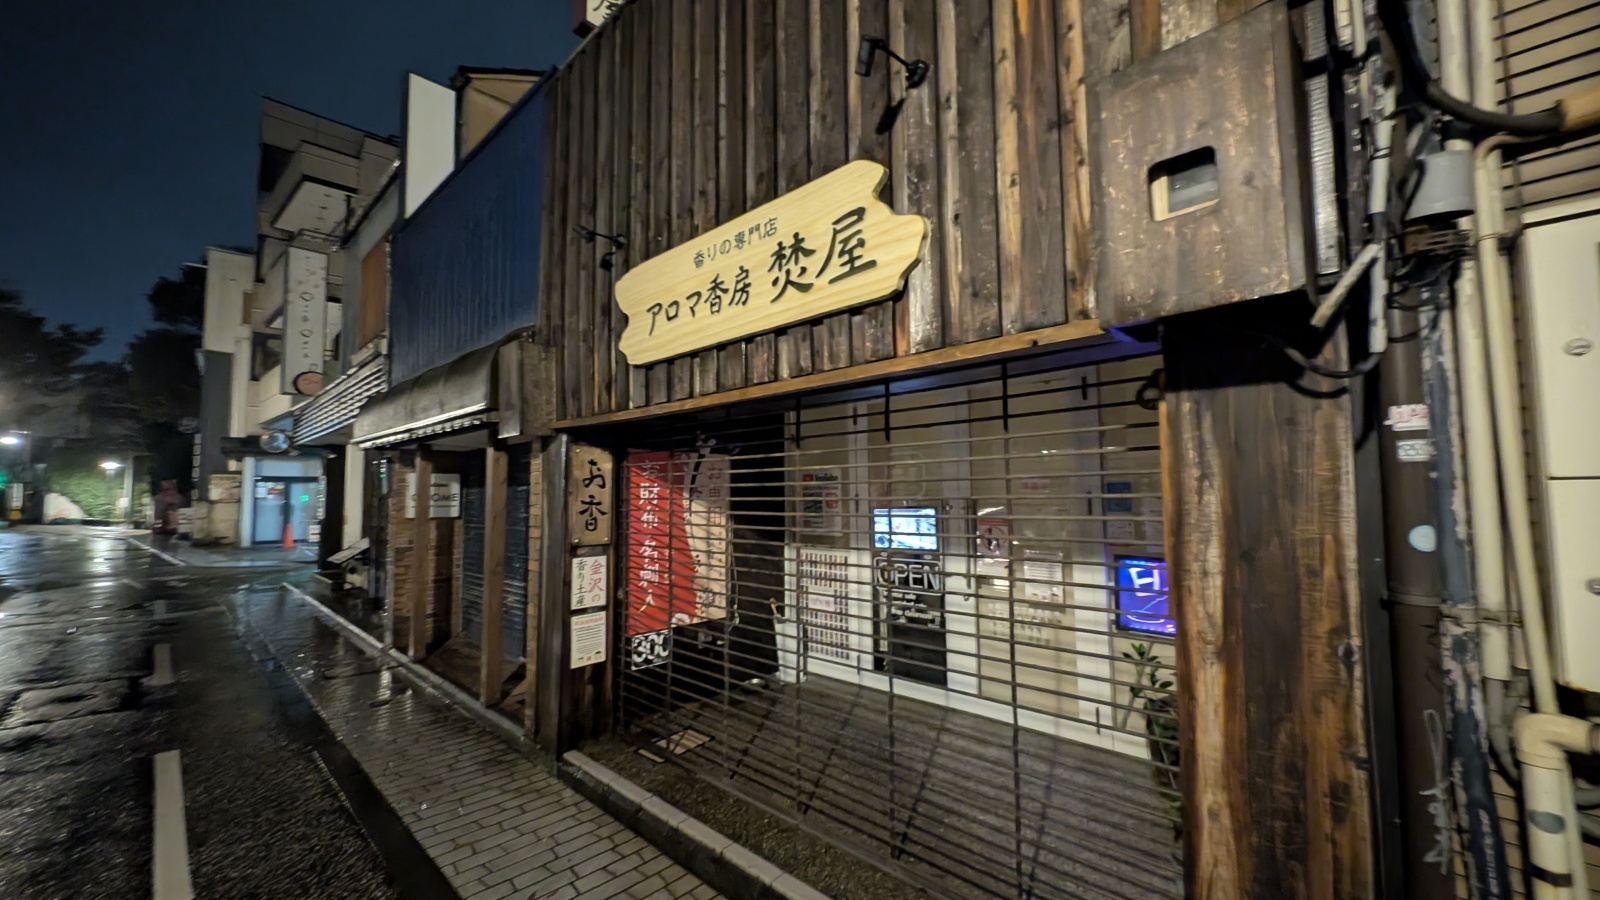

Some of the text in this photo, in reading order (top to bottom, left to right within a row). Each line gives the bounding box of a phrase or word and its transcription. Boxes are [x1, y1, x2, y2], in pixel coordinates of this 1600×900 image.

[693, 217, 778, 269] 香りの専門店
[646, 206, 877, 336] アロマ香房 焚屋
[579, 459, 608, 532] お香
[587, 559, 605, 603] 金沢の
[878, 561, 940, 590] OPEN
